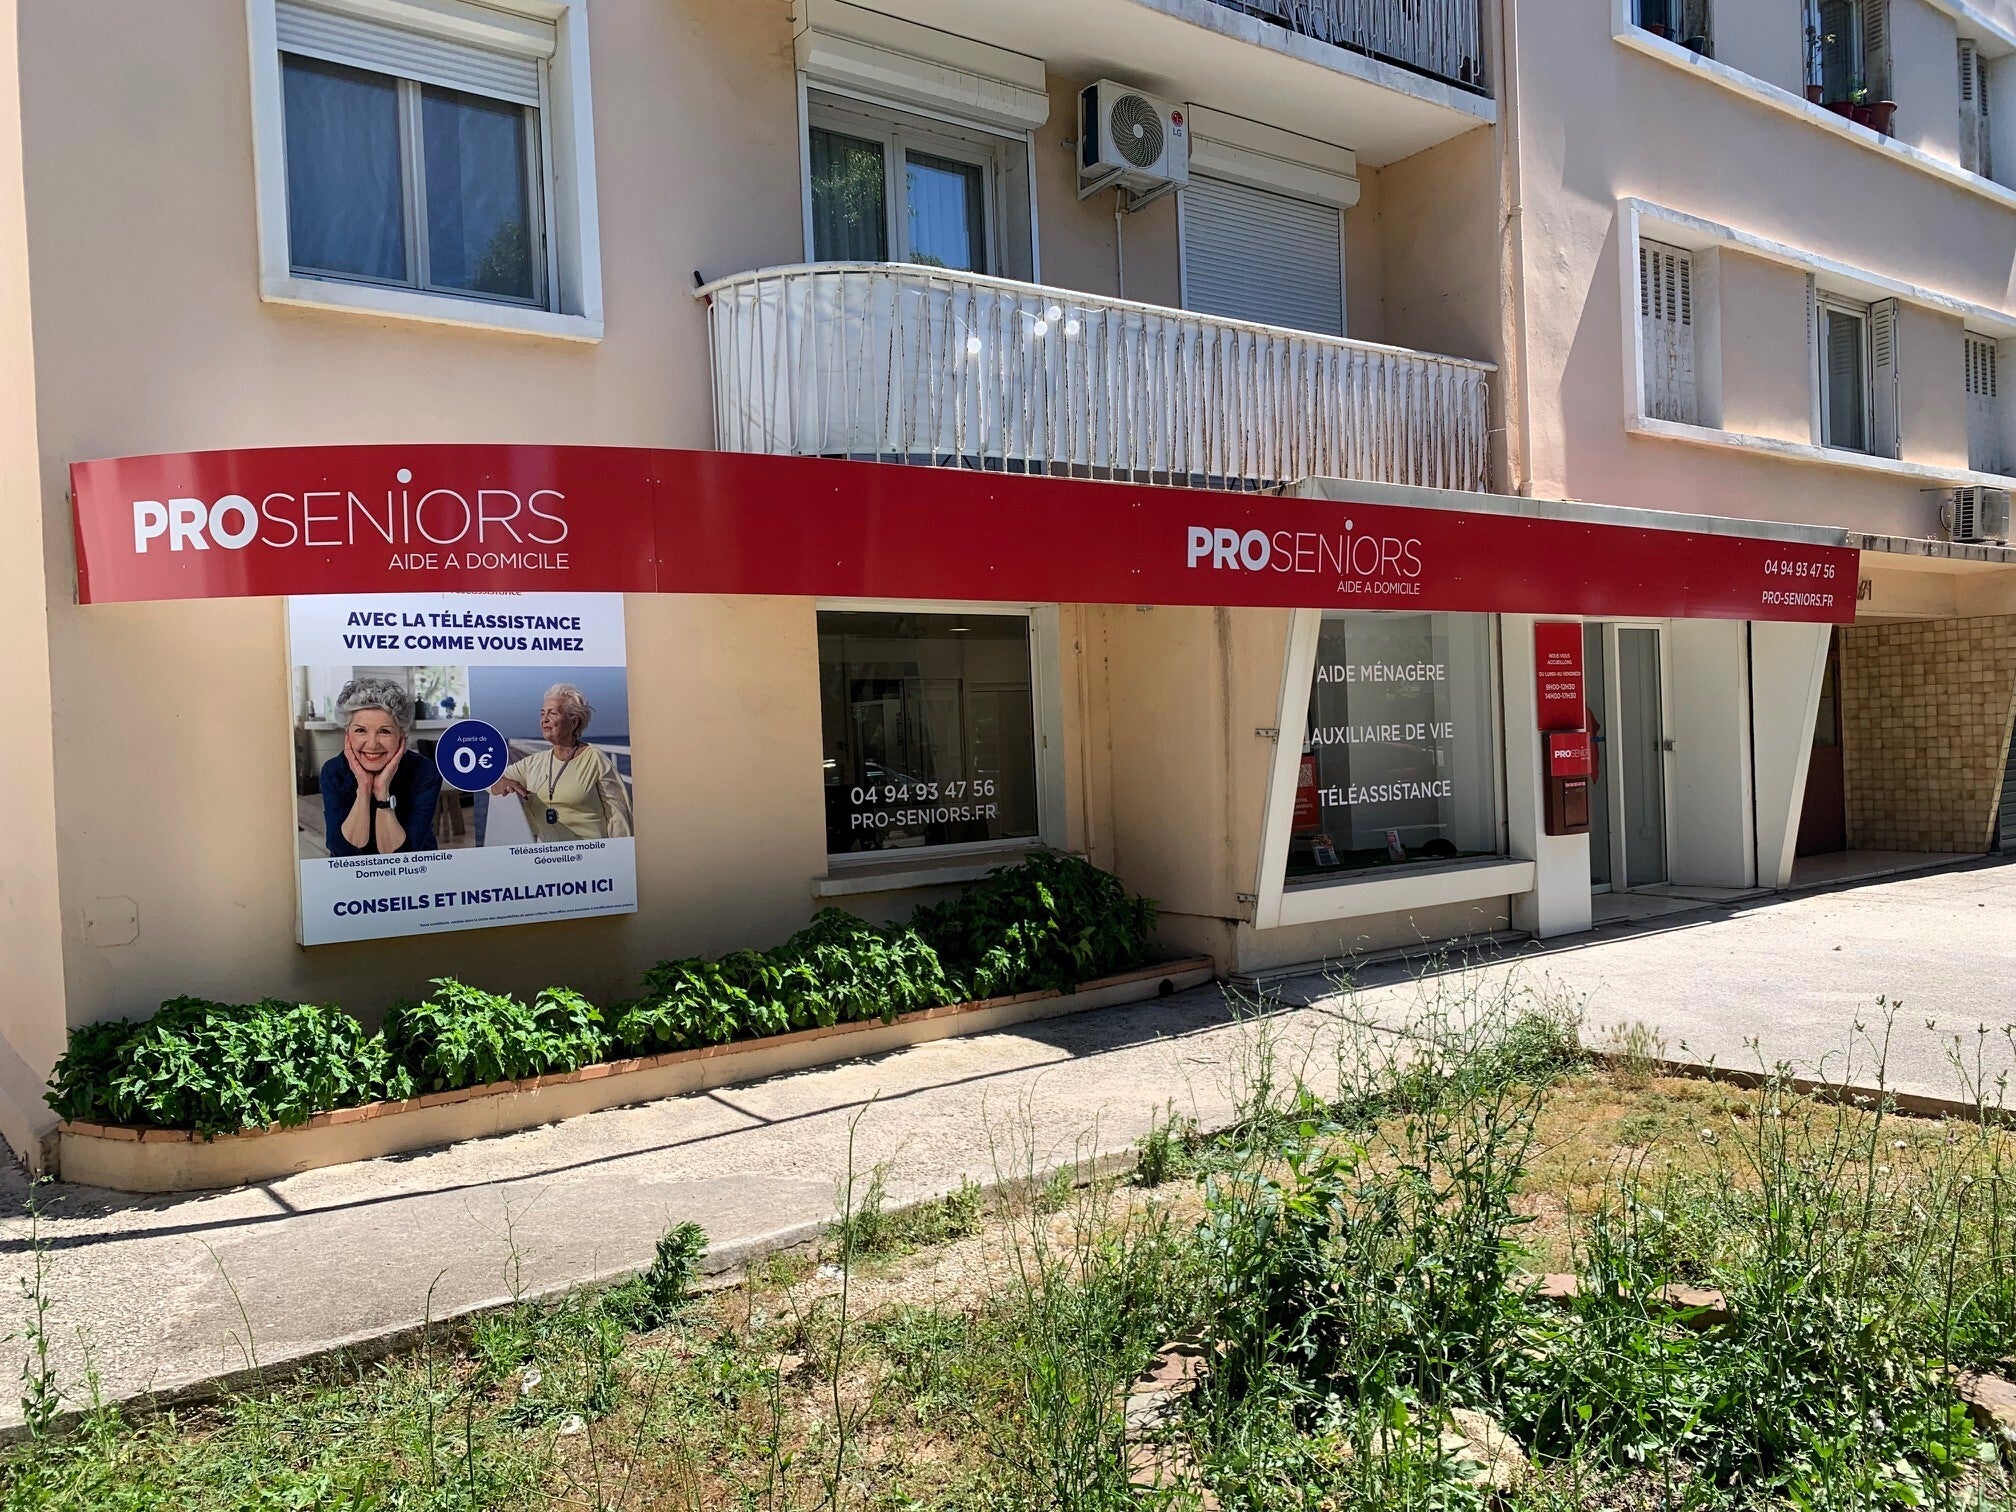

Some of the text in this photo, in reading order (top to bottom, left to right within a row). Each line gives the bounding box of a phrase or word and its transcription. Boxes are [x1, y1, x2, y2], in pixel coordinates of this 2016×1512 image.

[1172, 127, 1182, 138] LG
[388, 552, 570, 571] AIDE A DOMICILE
[1764, 559, 1835, 579] 04 94 93 47 56
[1337, 580, 1421, 595] AIDE A DOMICILE
[1762, 590, 1833, 608] PRO-SENIORS.FR
[347, 610, 581, 630] AVEC LA TÉLÉASSISTANCE
[342, 634, 584, 652] VIVEZ COMME VOUS AIMEZ
[1316, 661, 1445, 683] AIDE MÉNAGÈRE
[463, 735, 478, 743] partir
[1311, 722, 1454, 746] AUXILIAIRE DE VIE
[850, 780, 995, 805] 04 94 93 47 56
[1317, 780, 1451, 808] TÉLÉASSISTANCE
[851, 804, 996, 830] PRO-SENIORS.FR
[509, 841, 606, 856] Téléassistance mobile
[327, 852, 453, 869] Téléassistance à domicile
[355, 865, 428, 879] Domveil Plus®
[333, 893, 430, 917] CONSEILS
[435, 892, 457, 908] ET
[461, 881, 587, 906] INSTALLATION
[591, 878, 613, 893] ICI
